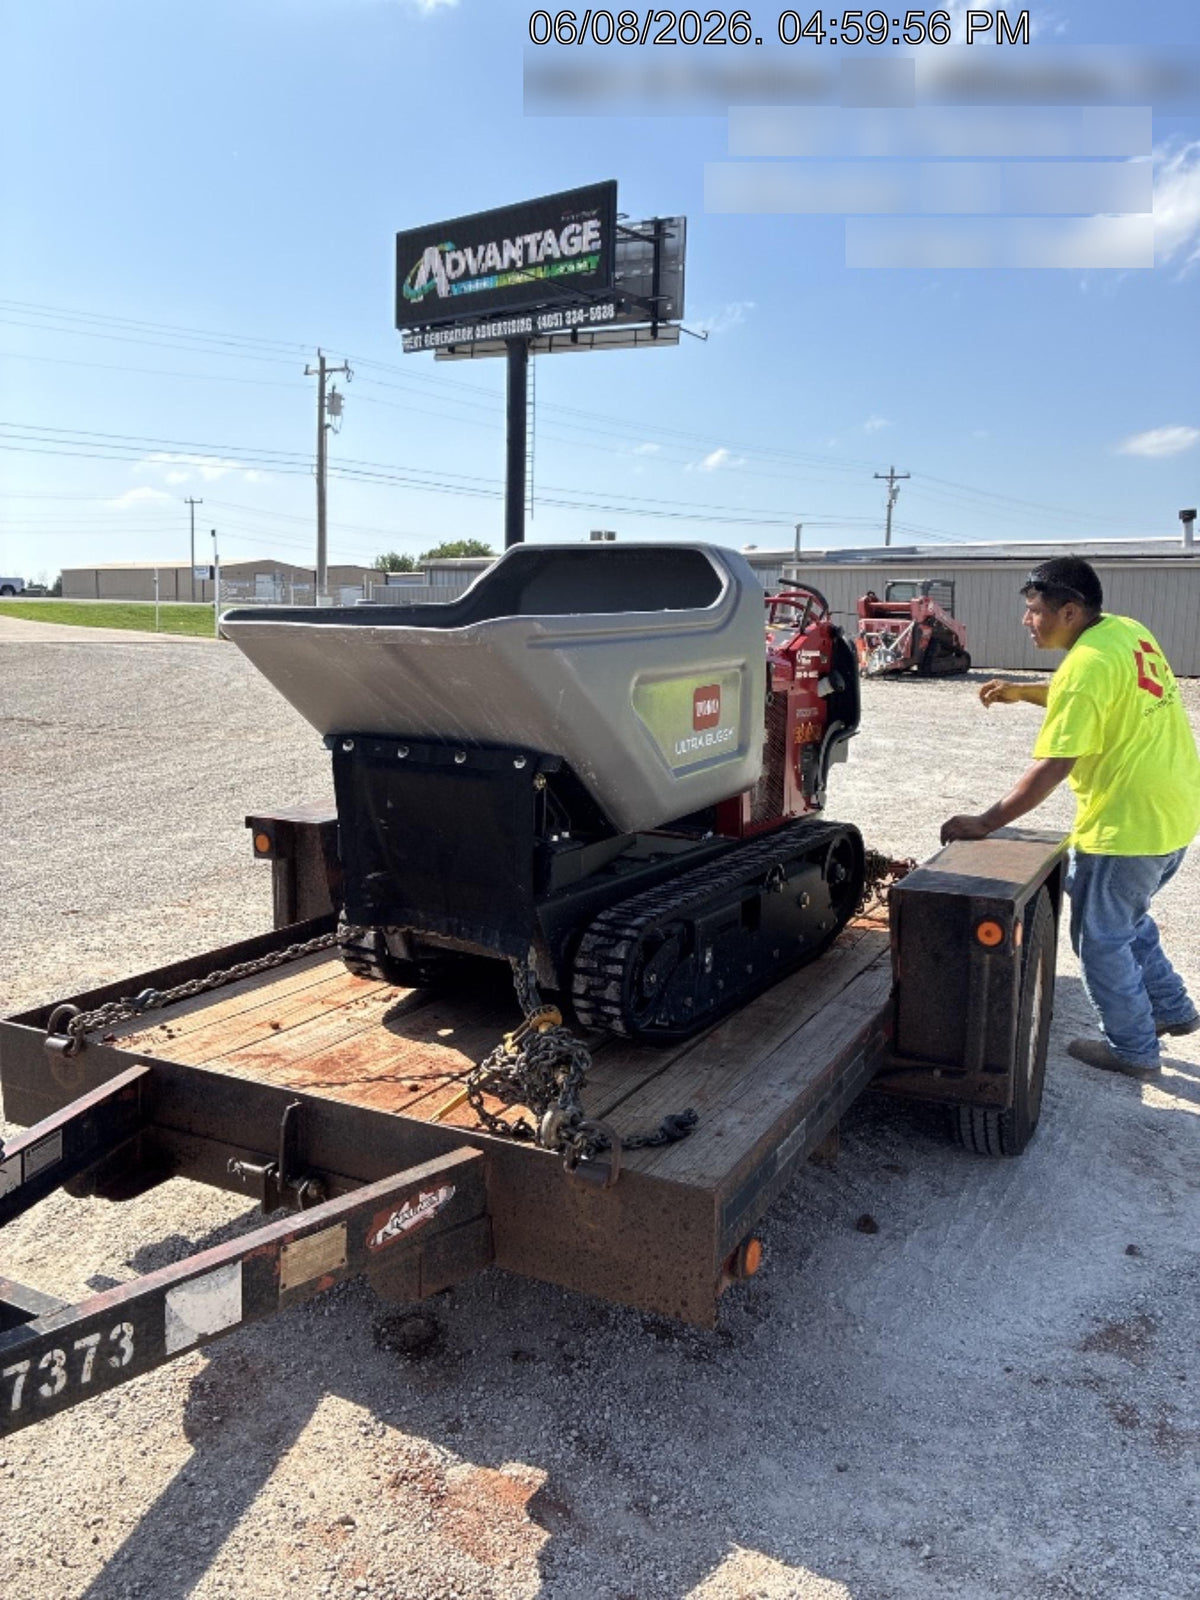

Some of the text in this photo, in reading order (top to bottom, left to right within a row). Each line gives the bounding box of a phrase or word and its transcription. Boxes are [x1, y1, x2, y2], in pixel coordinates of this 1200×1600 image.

[411, 219, 602, 303] ADVANTAGE
[476, 318, 532, 339] ADVERTISING
[3, 1322, 134, 1412] 7373
